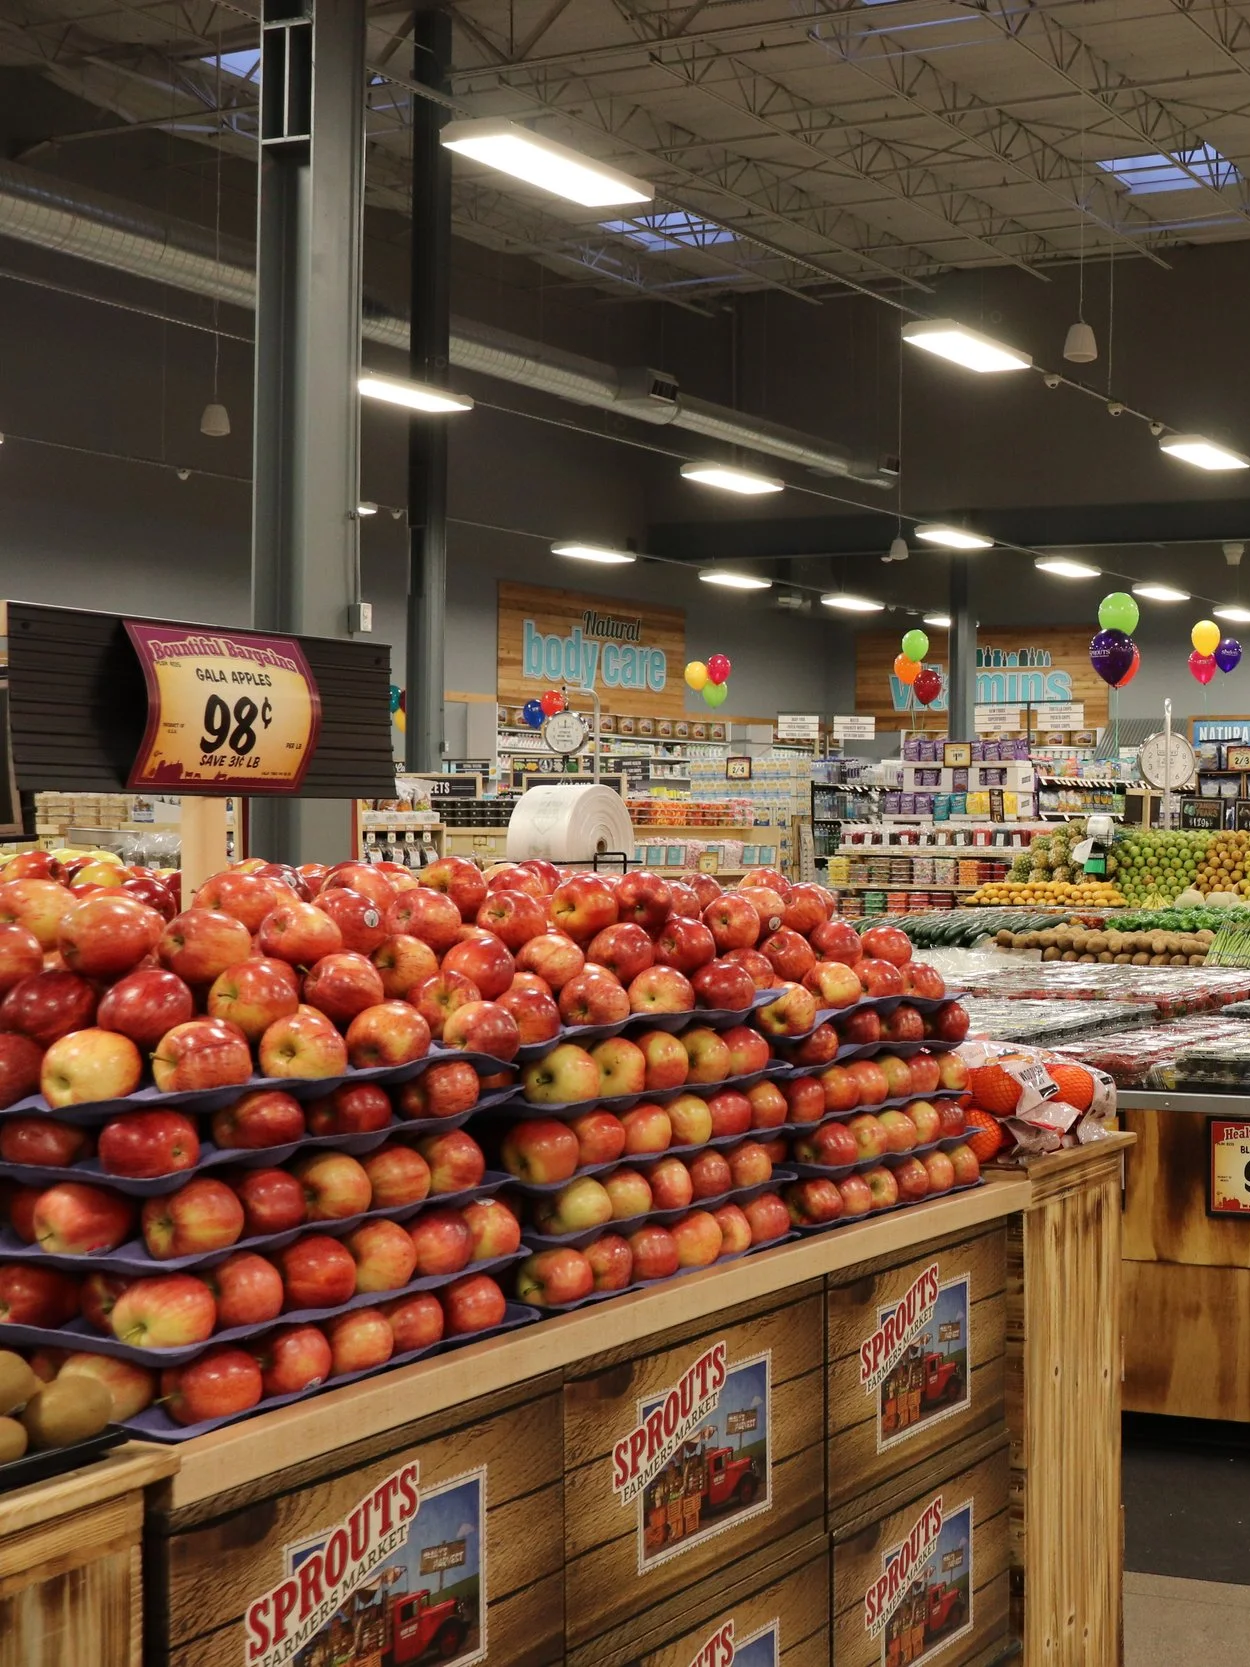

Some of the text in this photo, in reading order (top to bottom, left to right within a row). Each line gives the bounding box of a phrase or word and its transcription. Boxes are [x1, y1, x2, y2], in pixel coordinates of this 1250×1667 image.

[150, 636, 298, 673] Bountiful Bargains
[522, 618, 667, 693] body care
[583, 609, 642, 642] Natural
[196, 668, 272, 687] GALA APPLES
[199, 754, 226, 767] SAVE
[247, 756, 260, 768] LB
[200, 693, 272, 756] 98¢
[862, 1266, 938, 1380] SPROUTS
[867, 1306, 933, 1392] FARMERS MARKET
[614, 1344, 725, 1488] SPROUTS
[624, 1392, 718, 1502] FARMERS MARKET
[248, 1465, 419, 1660] SPROUTS
[262, 1524, 408, 1667] FARMERS MARKET
[866, 1498, 942, 1625] SPROUTS
[872, 1539, 937, 1636] FARMERS MARKET
